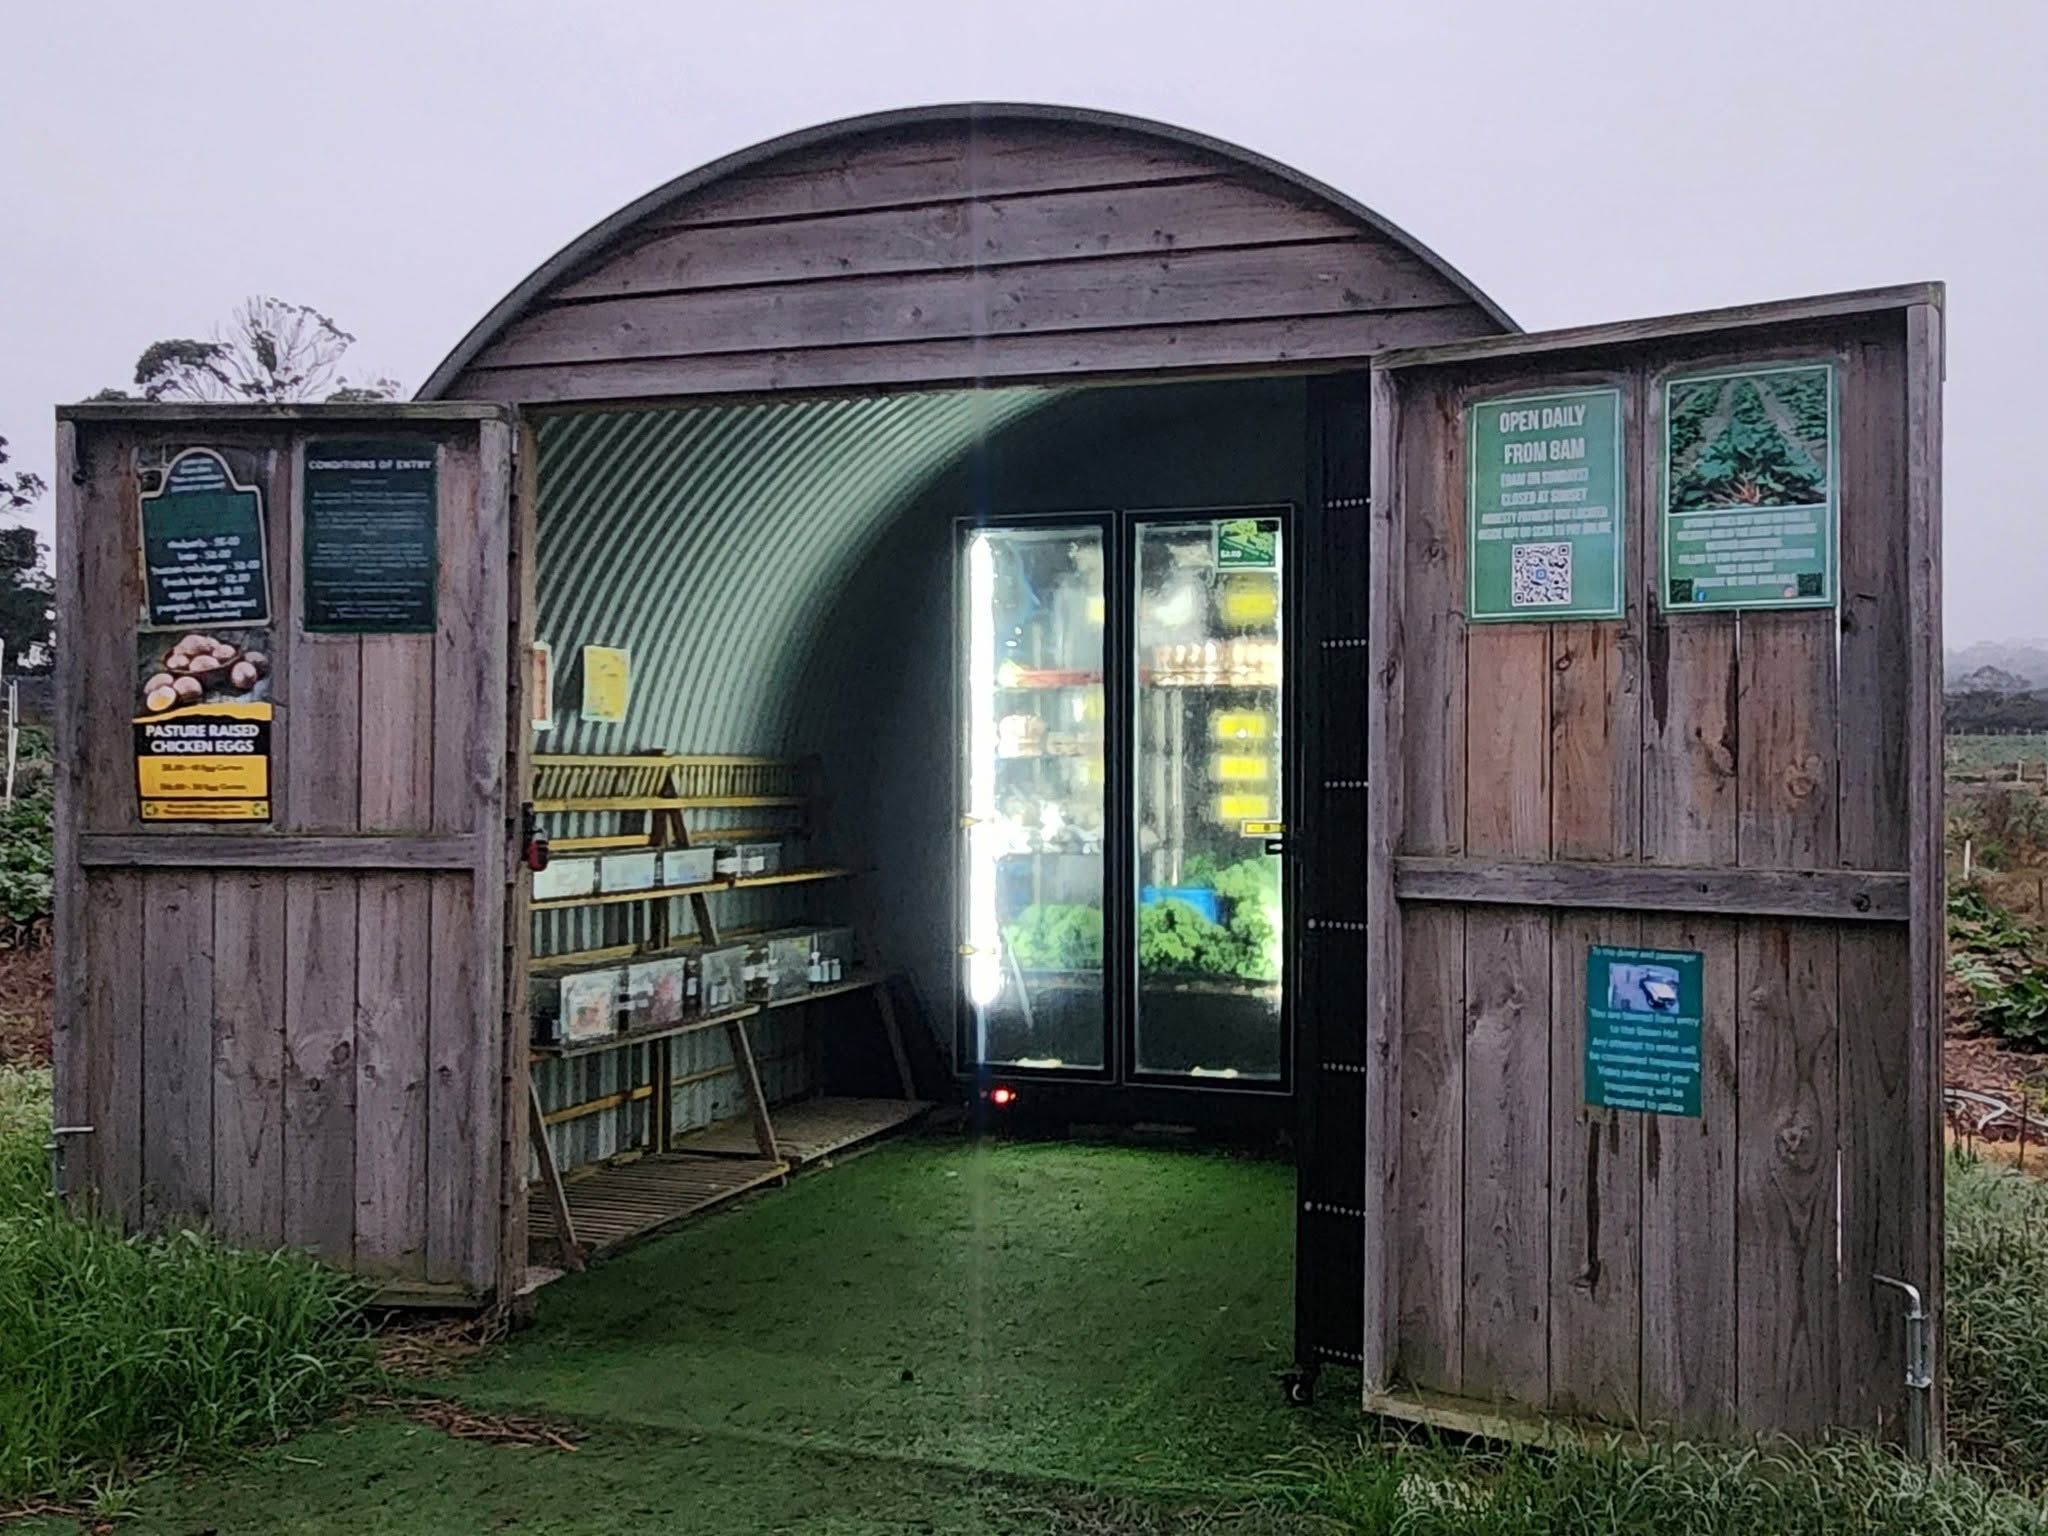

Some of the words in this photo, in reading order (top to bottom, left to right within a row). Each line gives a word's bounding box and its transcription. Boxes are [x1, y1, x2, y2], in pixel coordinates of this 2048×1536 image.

[1500, 410, 1539, 433] OPEN
[1542, 405, 1586, 429] DAILY
[1504, 442, 1546, 464] FROM
[1550, 438, 1585, 460] 8AM
[308, 460, 376, 470] CONDITIONS
[396, 460, 432, 470] ENTRY
[1501, 491, 1536, 506] CLOSED
[1537, 490, 1549, 503] AT
[145, 724, 206, 737] PASTURE
[208, 724, 260, 737] RAISED
[150, 740, 212, 752] CHICKEN
[215, 740, 254, 752] EGGS
[1590, 1008, 1606, 1018] You
[1608, 1010, 1621, 1020] are
[1676, 1017, 1700, 1027] entry
[1610, 1025, 1619, 1034] to
[1620, 1025, 1635, 1035] the
[1592, 1037, 1608, 1048] Any
